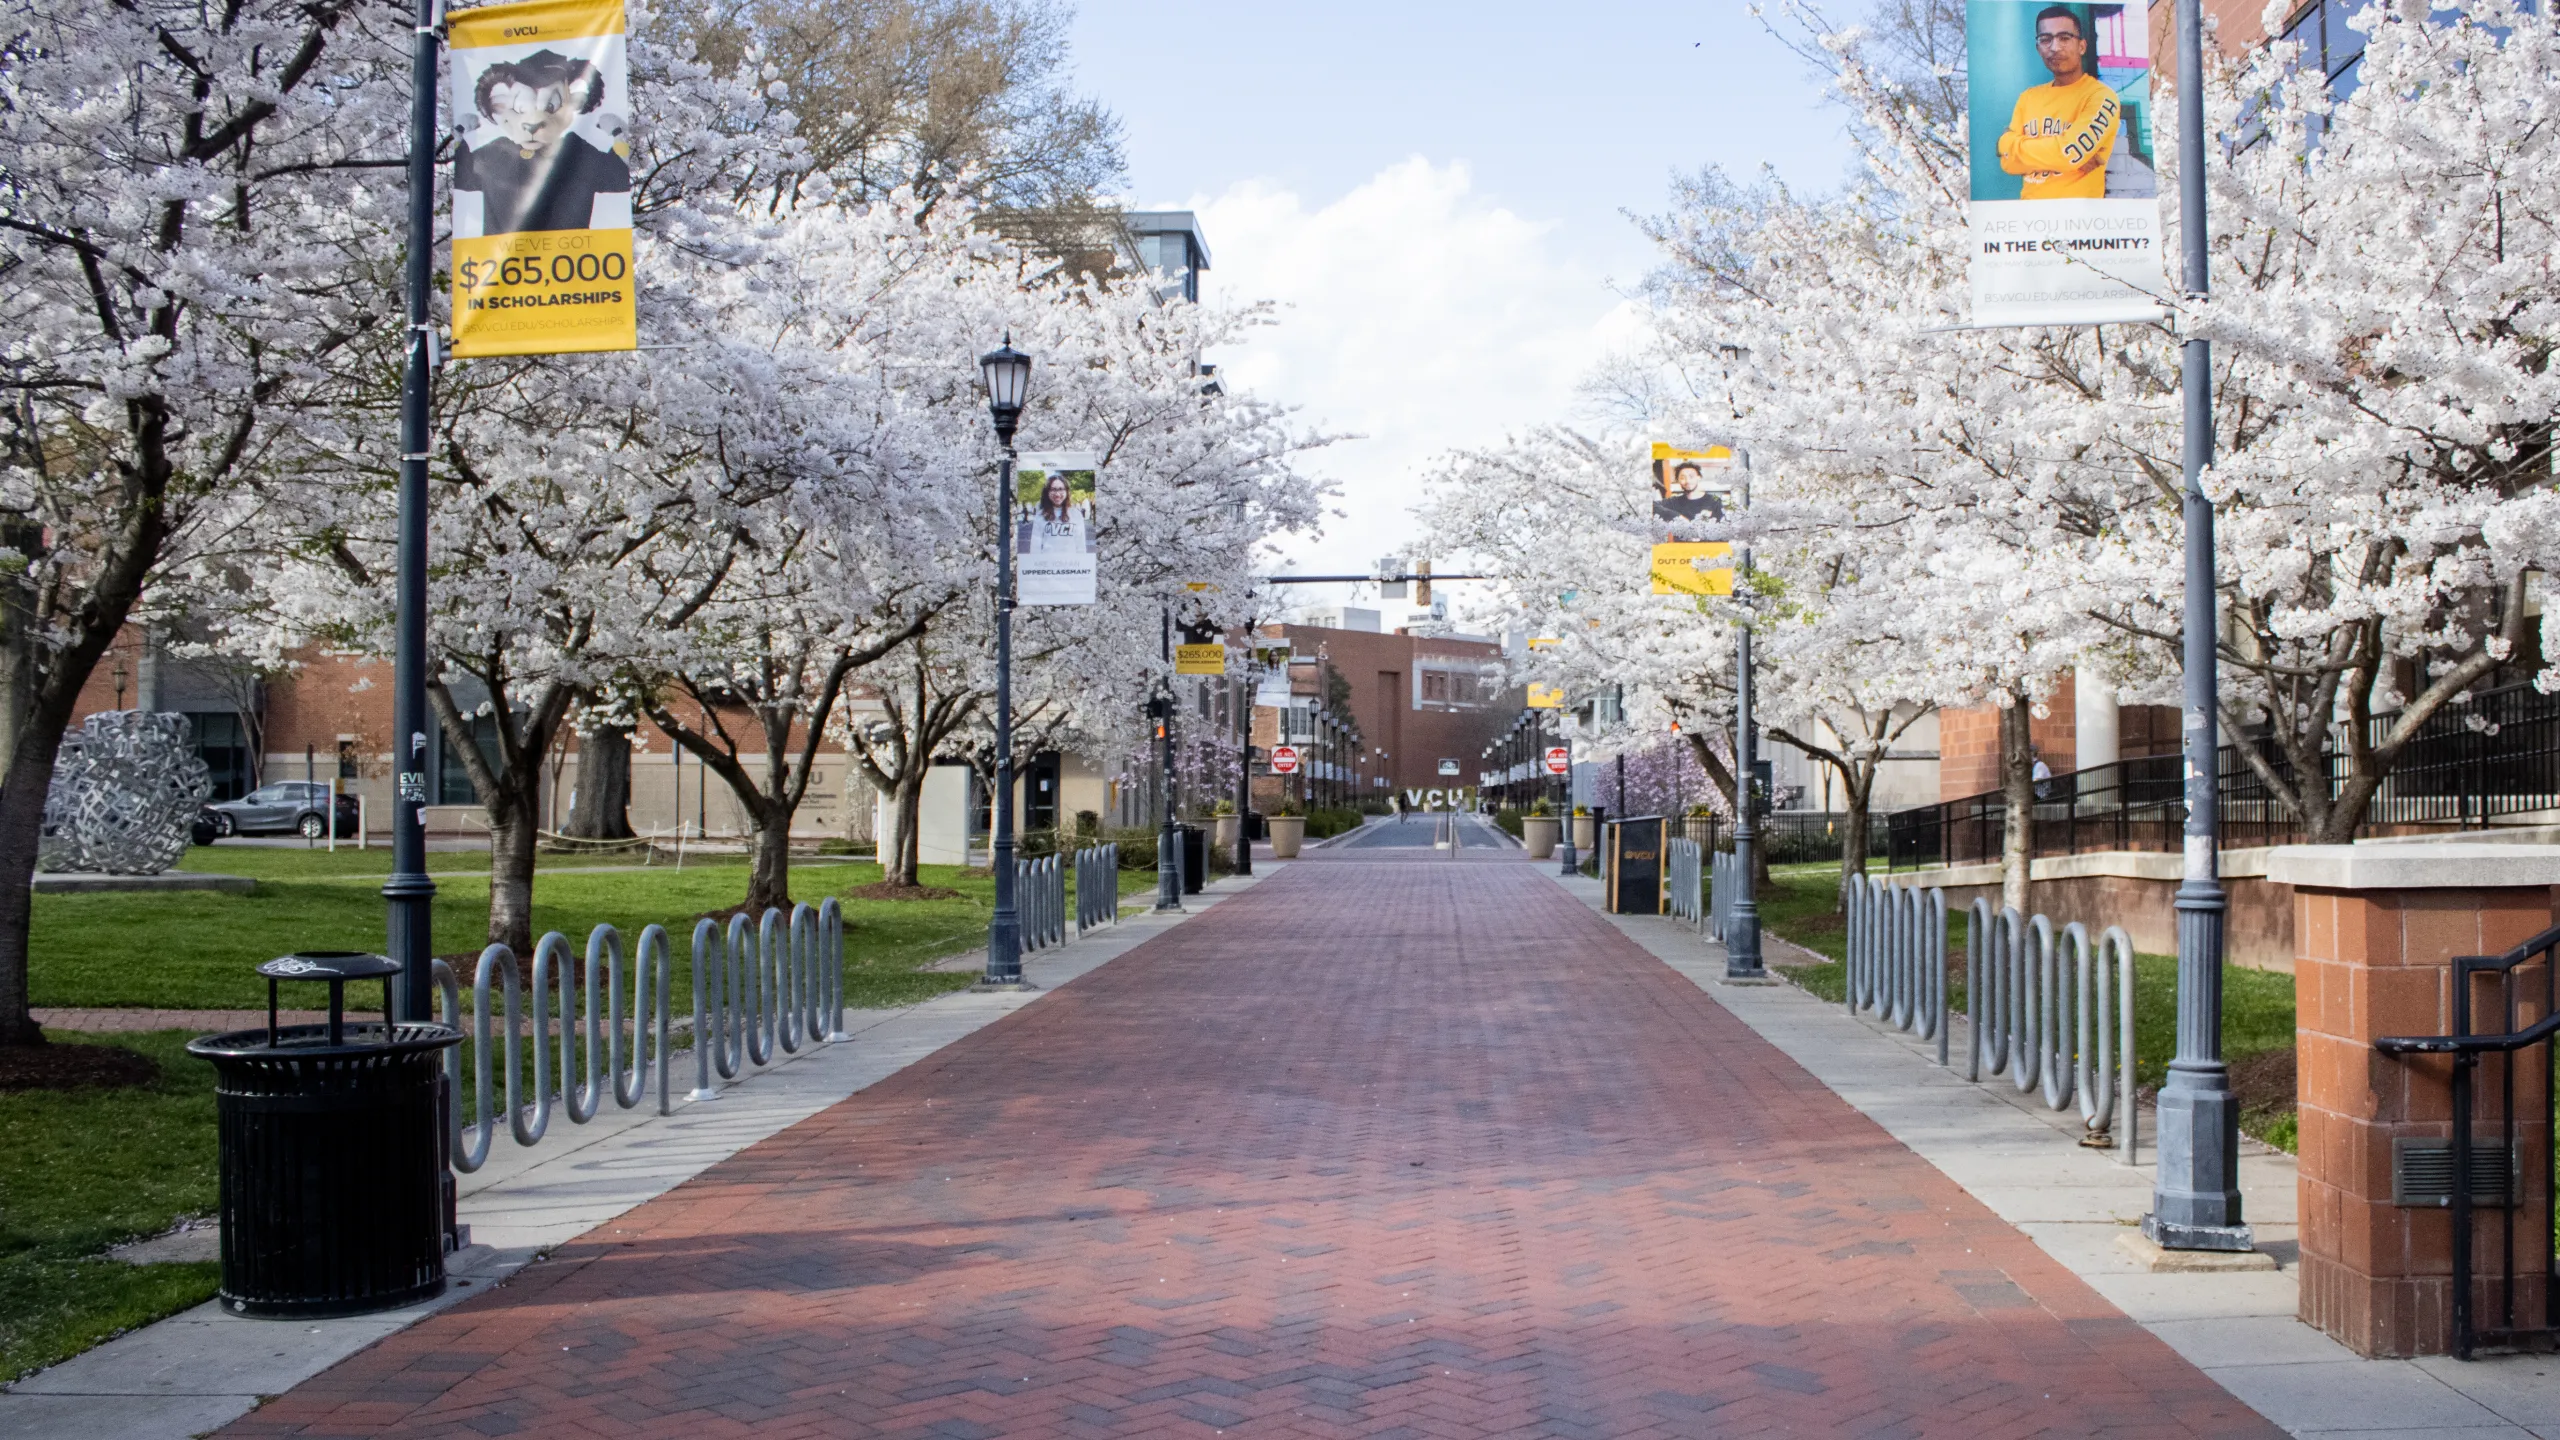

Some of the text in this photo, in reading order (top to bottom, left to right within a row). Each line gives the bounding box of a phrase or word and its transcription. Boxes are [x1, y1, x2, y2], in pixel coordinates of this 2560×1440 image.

[513, 26, 538, 37] VCU
[2064, 98, 2118, 164] HAVOC
[1984, 217, 2149, 233] ARE YOU INVOLVED
[558, 235, 593, 250] GOT
[1984, 242, 2001, 254] IN
[2004, 240, 2037, 253] THE
[459, 252, 627, 294] $265,000
[467, 291, 623, 310] IN SCHOLARSHIPS
[1177, 650, 1222, 660] $265,000
[1406, 788, 1463, 807] VCU
